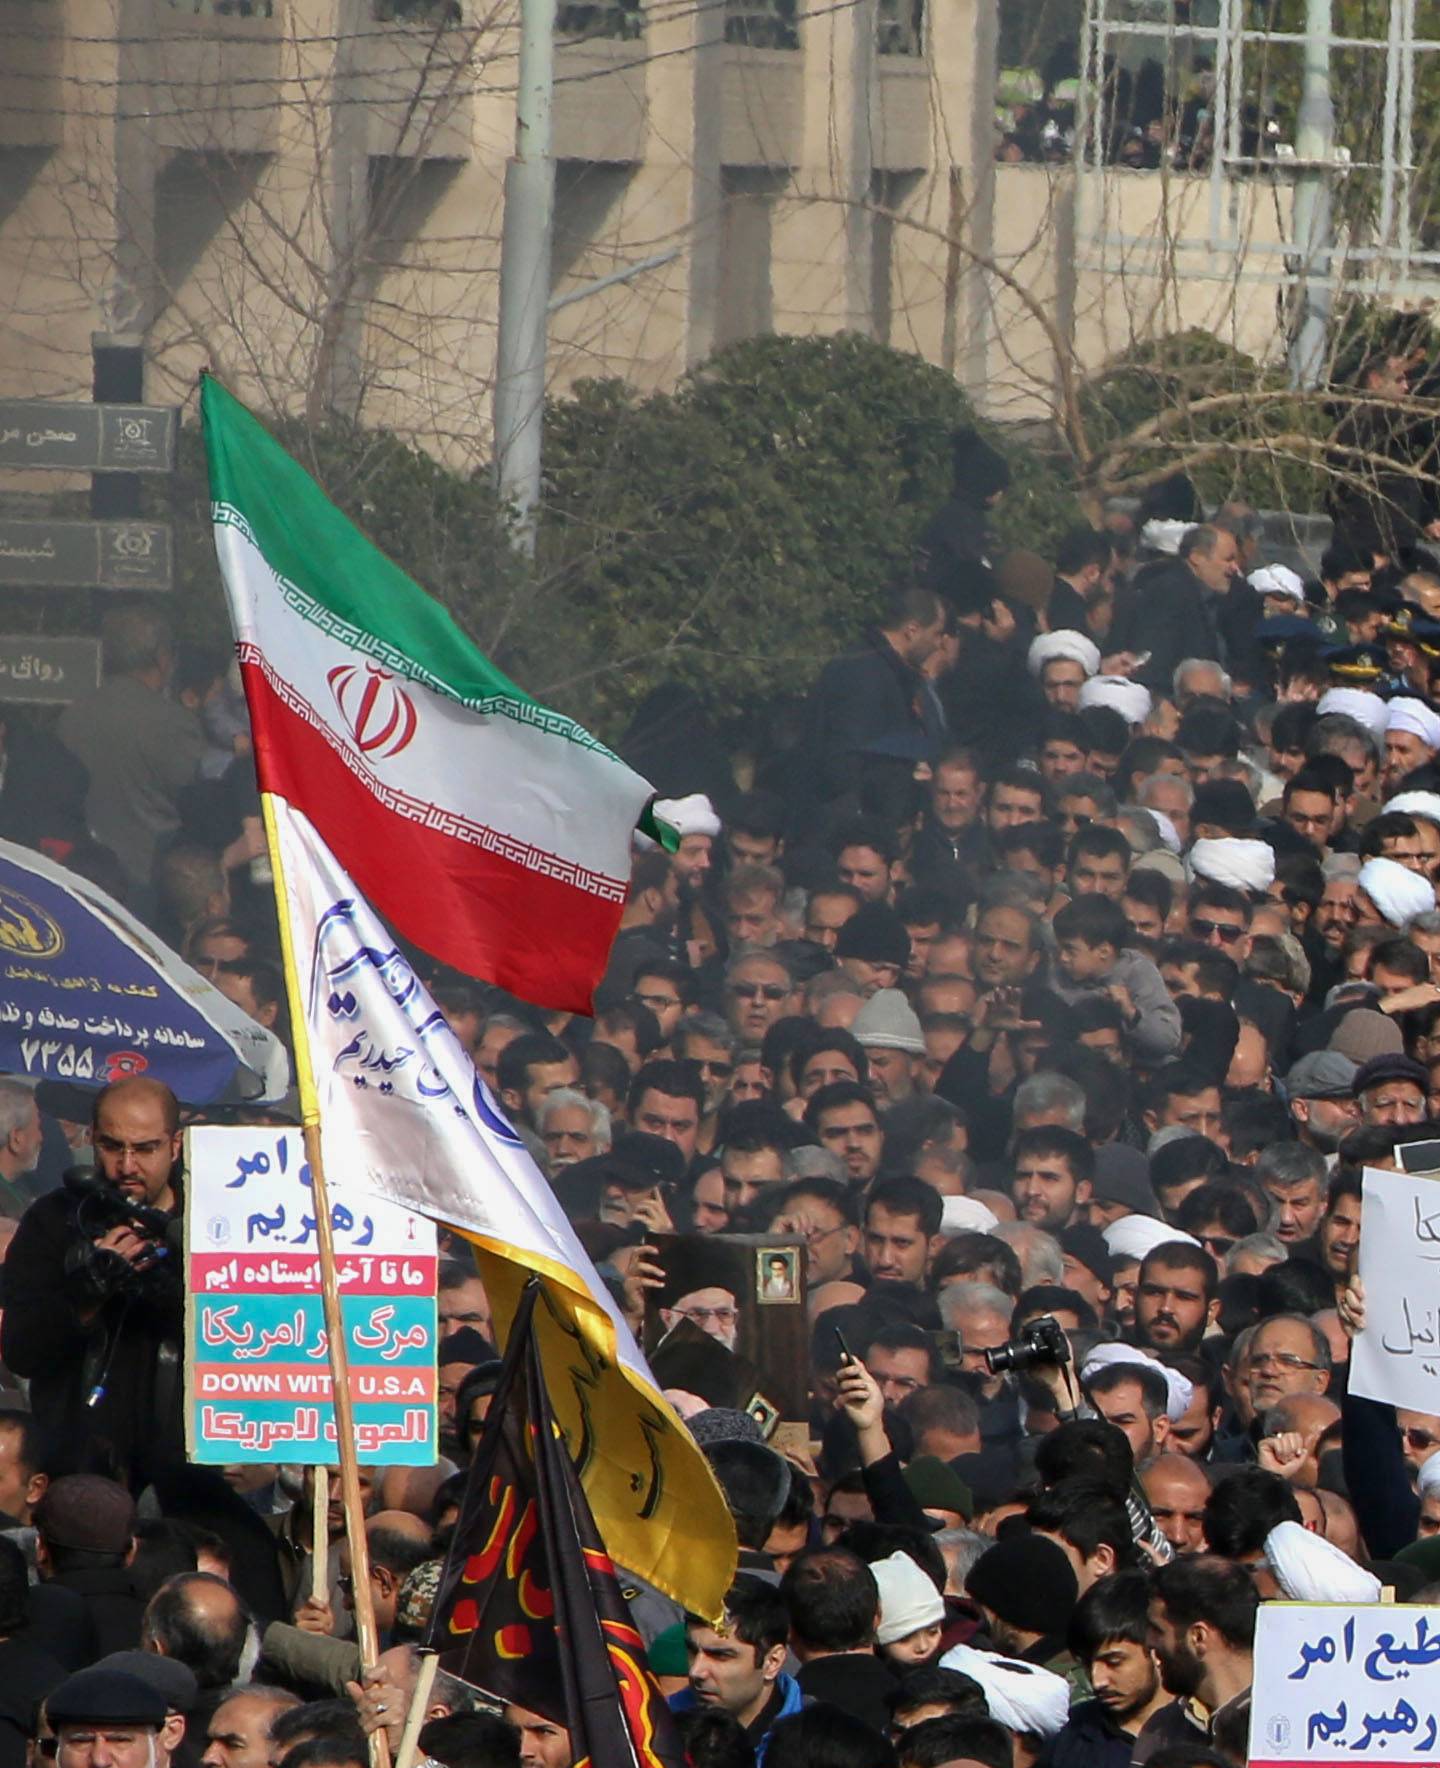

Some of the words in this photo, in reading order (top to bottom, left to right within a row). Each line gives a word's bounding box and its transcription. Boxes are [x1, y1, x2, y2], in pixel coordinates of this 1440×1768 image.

[24, 1009, 34, 1030] و
[38, 1007, 80, 1030] صدقه
[84, 1018, 149, 1047] پرداخت
[154, 1026, 205, 1049] سامانه
[225, 1136, 287, 1188] امر
[202, 1373, 281, 1393] DOWN
[359, 1375, 426, 1396] U.S.A
[1288, 1615, 1355, 1680] امر
[1307, 1697, 1438, 1750] رهبریم
